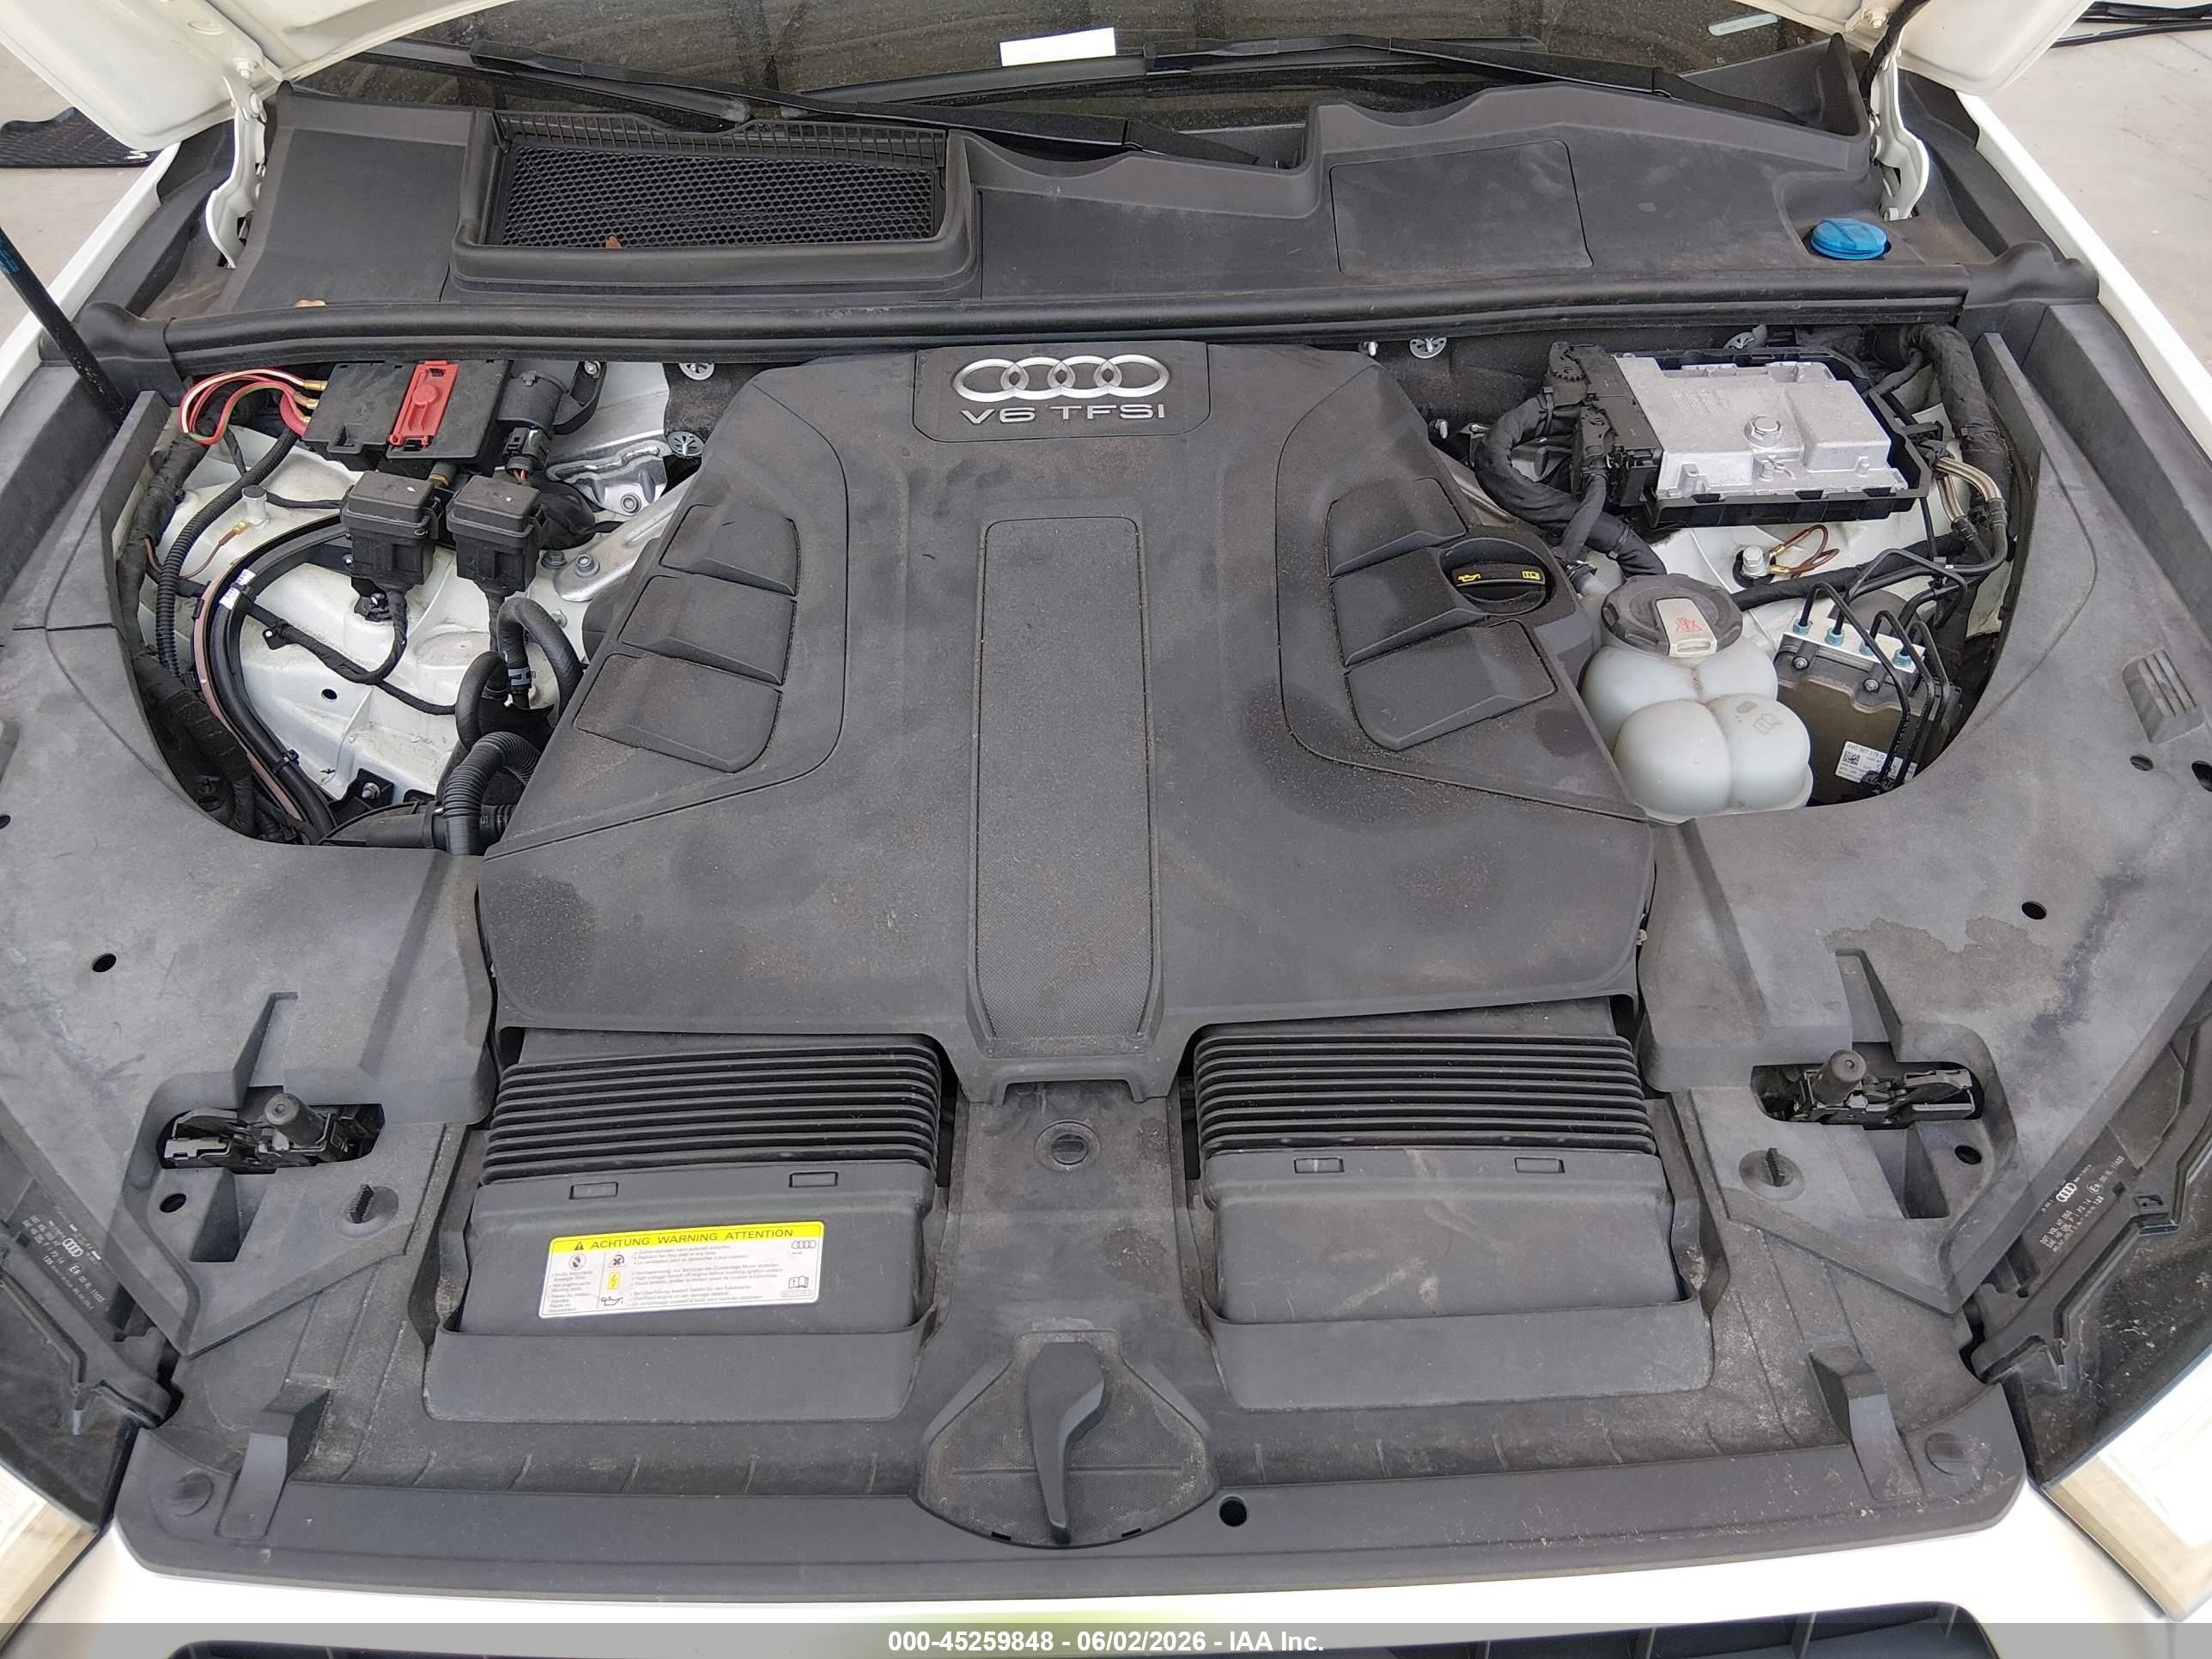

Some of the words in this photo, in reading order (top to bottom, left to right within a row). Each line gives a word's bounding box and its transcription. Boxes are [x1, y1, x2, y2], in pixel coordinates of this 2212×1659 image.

[960, 407, 1036, 425] V6
[1050, 404, 1165, 420] TFSI
[591, 1237, 650, 1249] ACHTUNG
[657, 1232, 718, 1243] WARNING
[725, 1228, 794, 1241] ATTENTION
